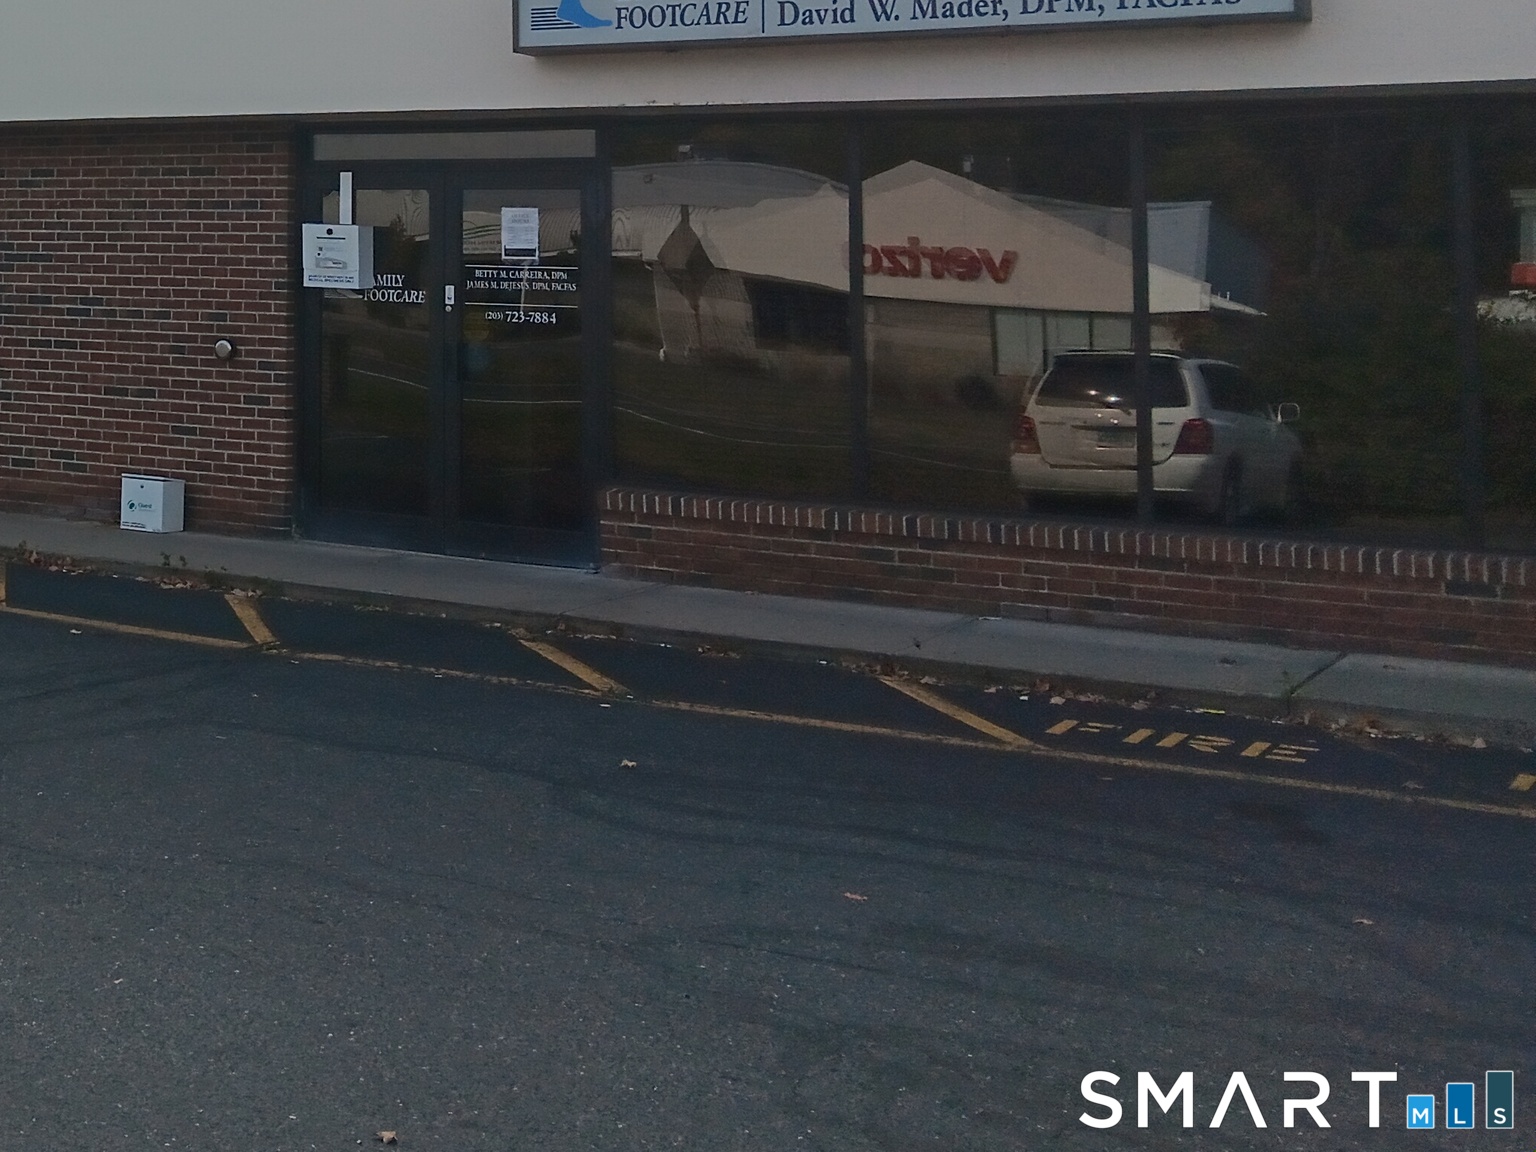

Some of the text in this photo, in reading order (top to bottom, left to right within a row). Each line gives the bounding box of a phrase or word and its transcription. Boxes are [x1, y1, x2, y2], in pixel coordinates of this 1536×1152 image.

[615, 1, 749, 30] FOOTCARE
[475, 269, 498, 278] BETTY
[551, 272, 568, 280] DPM
[466, 280, 489, 289] JAMES
[551, 282, 577, 291] FACFAS
[364, 289, 426, 303] FOOTCARE
[485, 311, 557, 324] (203) 723-7884
[1045, 719, 1320, 763] FIRE
